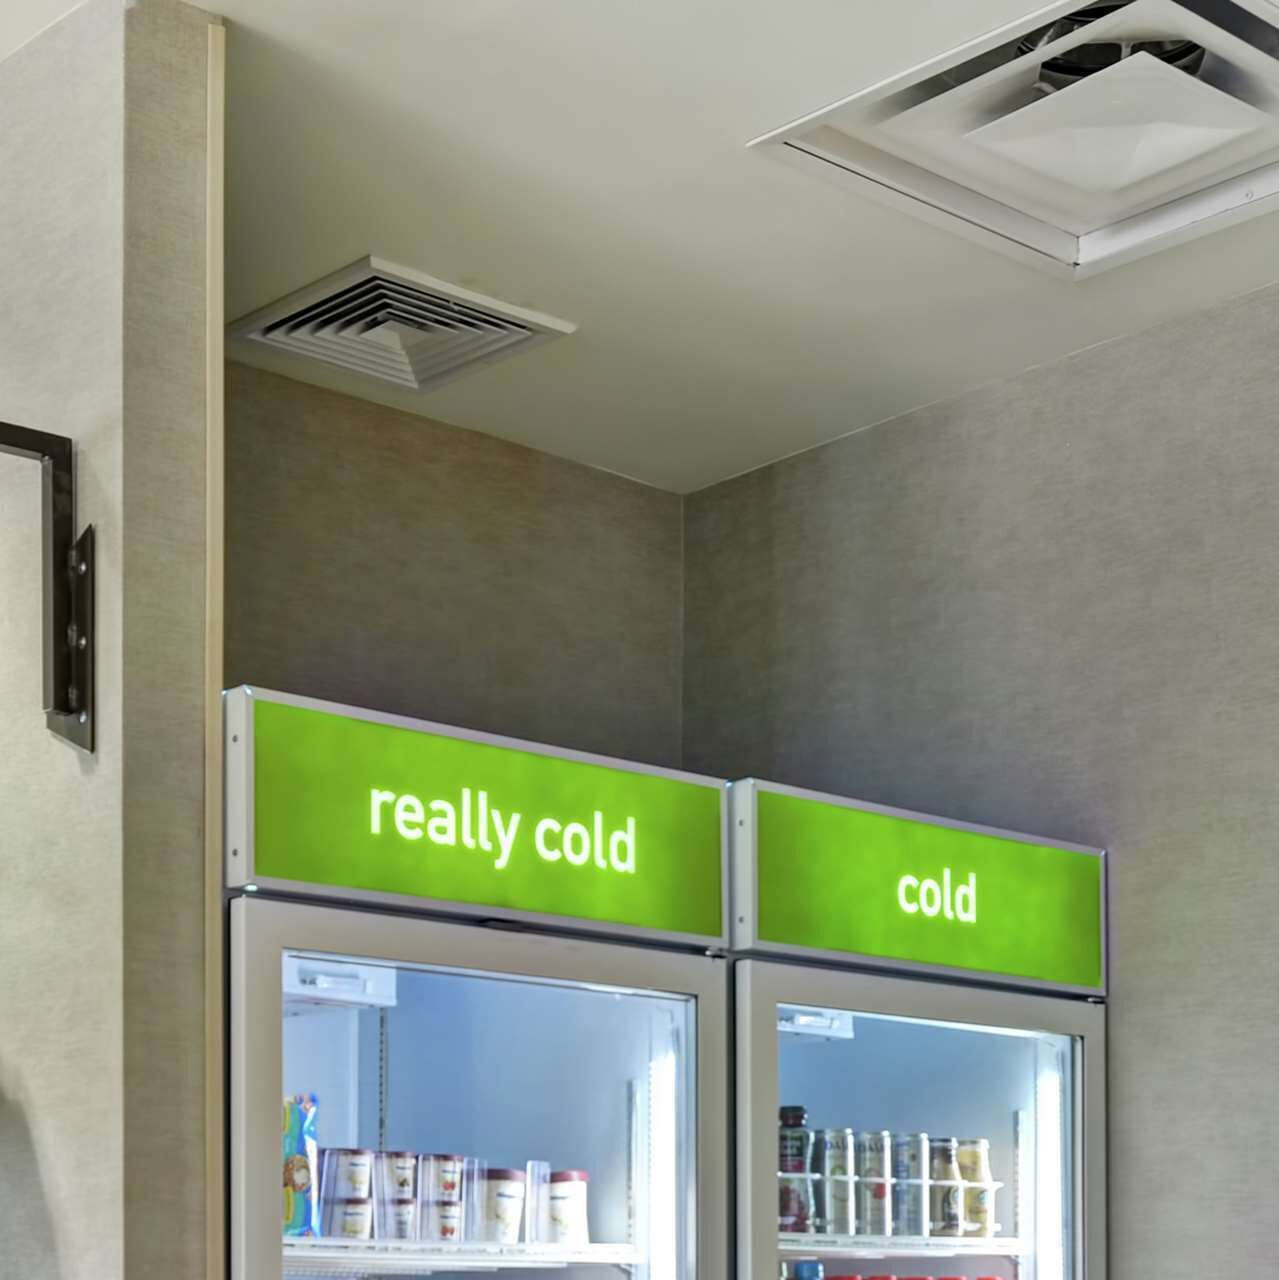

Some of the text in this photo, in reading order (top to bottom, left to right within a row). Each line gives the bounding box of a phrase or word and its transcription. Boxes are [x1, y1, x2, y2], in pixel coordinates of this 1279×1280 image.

[369, 787, 637, 875] really cold
[896, 867, 978, 925] cold
